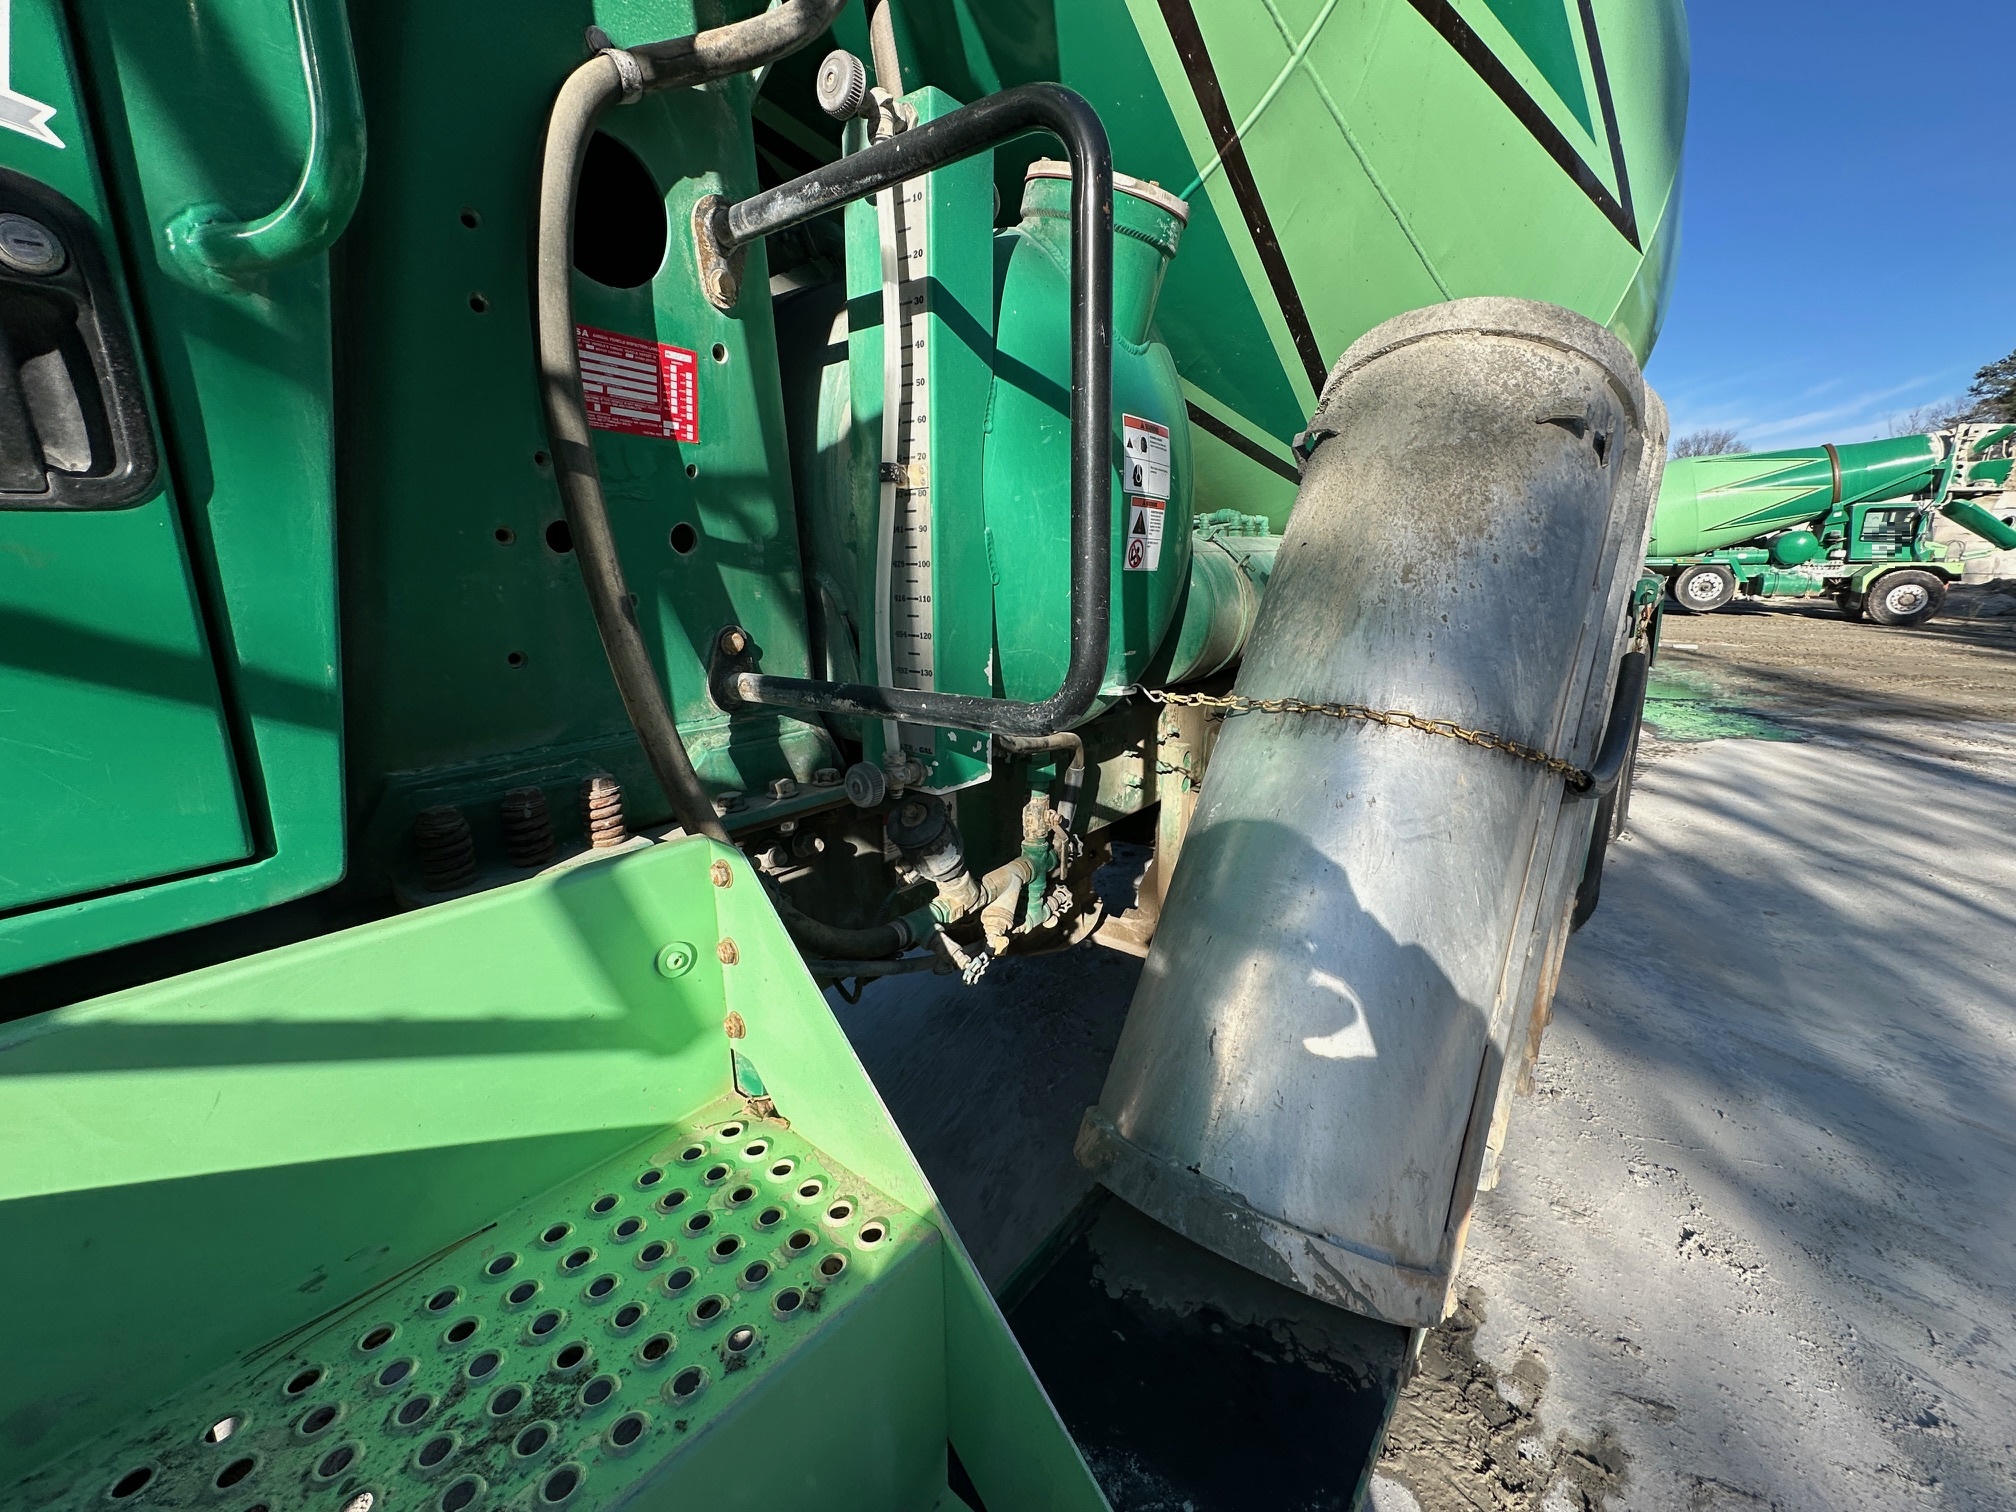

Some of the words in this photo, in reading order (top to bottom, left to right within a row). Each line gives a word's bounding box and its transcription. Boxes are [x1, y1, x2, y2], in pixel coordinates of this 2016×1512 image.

[912, 191, 923, 203] 10
[912, 248, 923, 259] 20
[913, 295, 924, 305] 30
[915, 339, 925, 349] 40
[915, 377, 925, 387] 50
[917, 414, 927, 424] 60
[917, 452, 927, 461] 70
[917, 489, 927, 497] 80
[918, 525, 927, 533] 90
[917, 560, 931, 568] 100
[918, 594, 931, 603] 110
[919, 632, 932, 640] 120
[920, 669, 933, 677] 130
[919, 746, 933, 755] GAL
